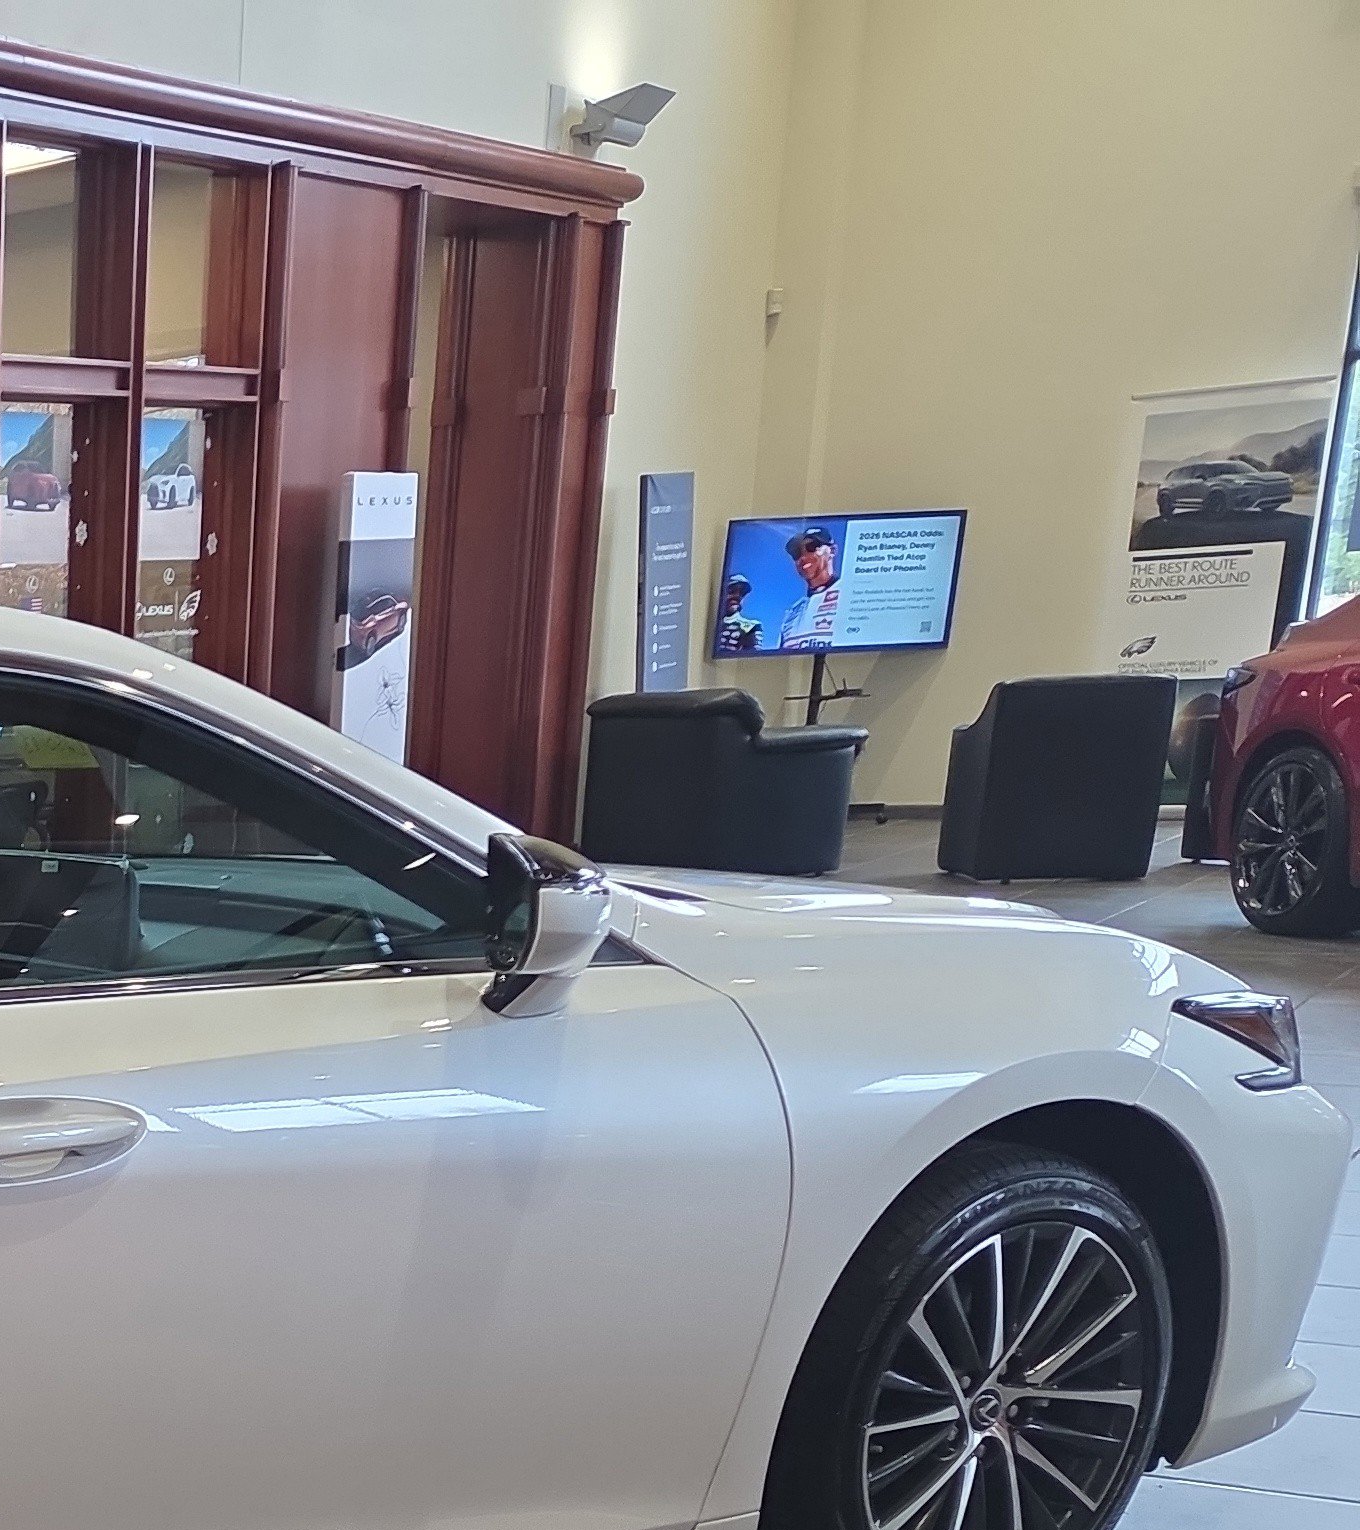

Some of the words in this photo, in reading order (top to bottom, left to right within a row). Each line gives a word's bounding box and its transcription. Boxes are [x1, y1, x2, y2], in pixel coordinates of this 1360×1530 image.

[357, 495, 414, 506] LEXUS
[882, 531, 918, 539] NASCAR
[857, 543, 878, 553] Ryan
[886, 553, 905, 561] Tied
[854, 565, 880, 574] Board
[880, 565, 892, 573] for
[893, 563, 927, 573] Phoenix
[1131, 562, 1155, 576] THE
[1159, 560, 1189, 575] BEST
[1191, 558, 1238, 573] ROUTE
[1129, 575, 1187, 589] RUNNER
[1187, 570, 1251, 586] AROUND
[1142, 593, 1187, 602] LEXUS
